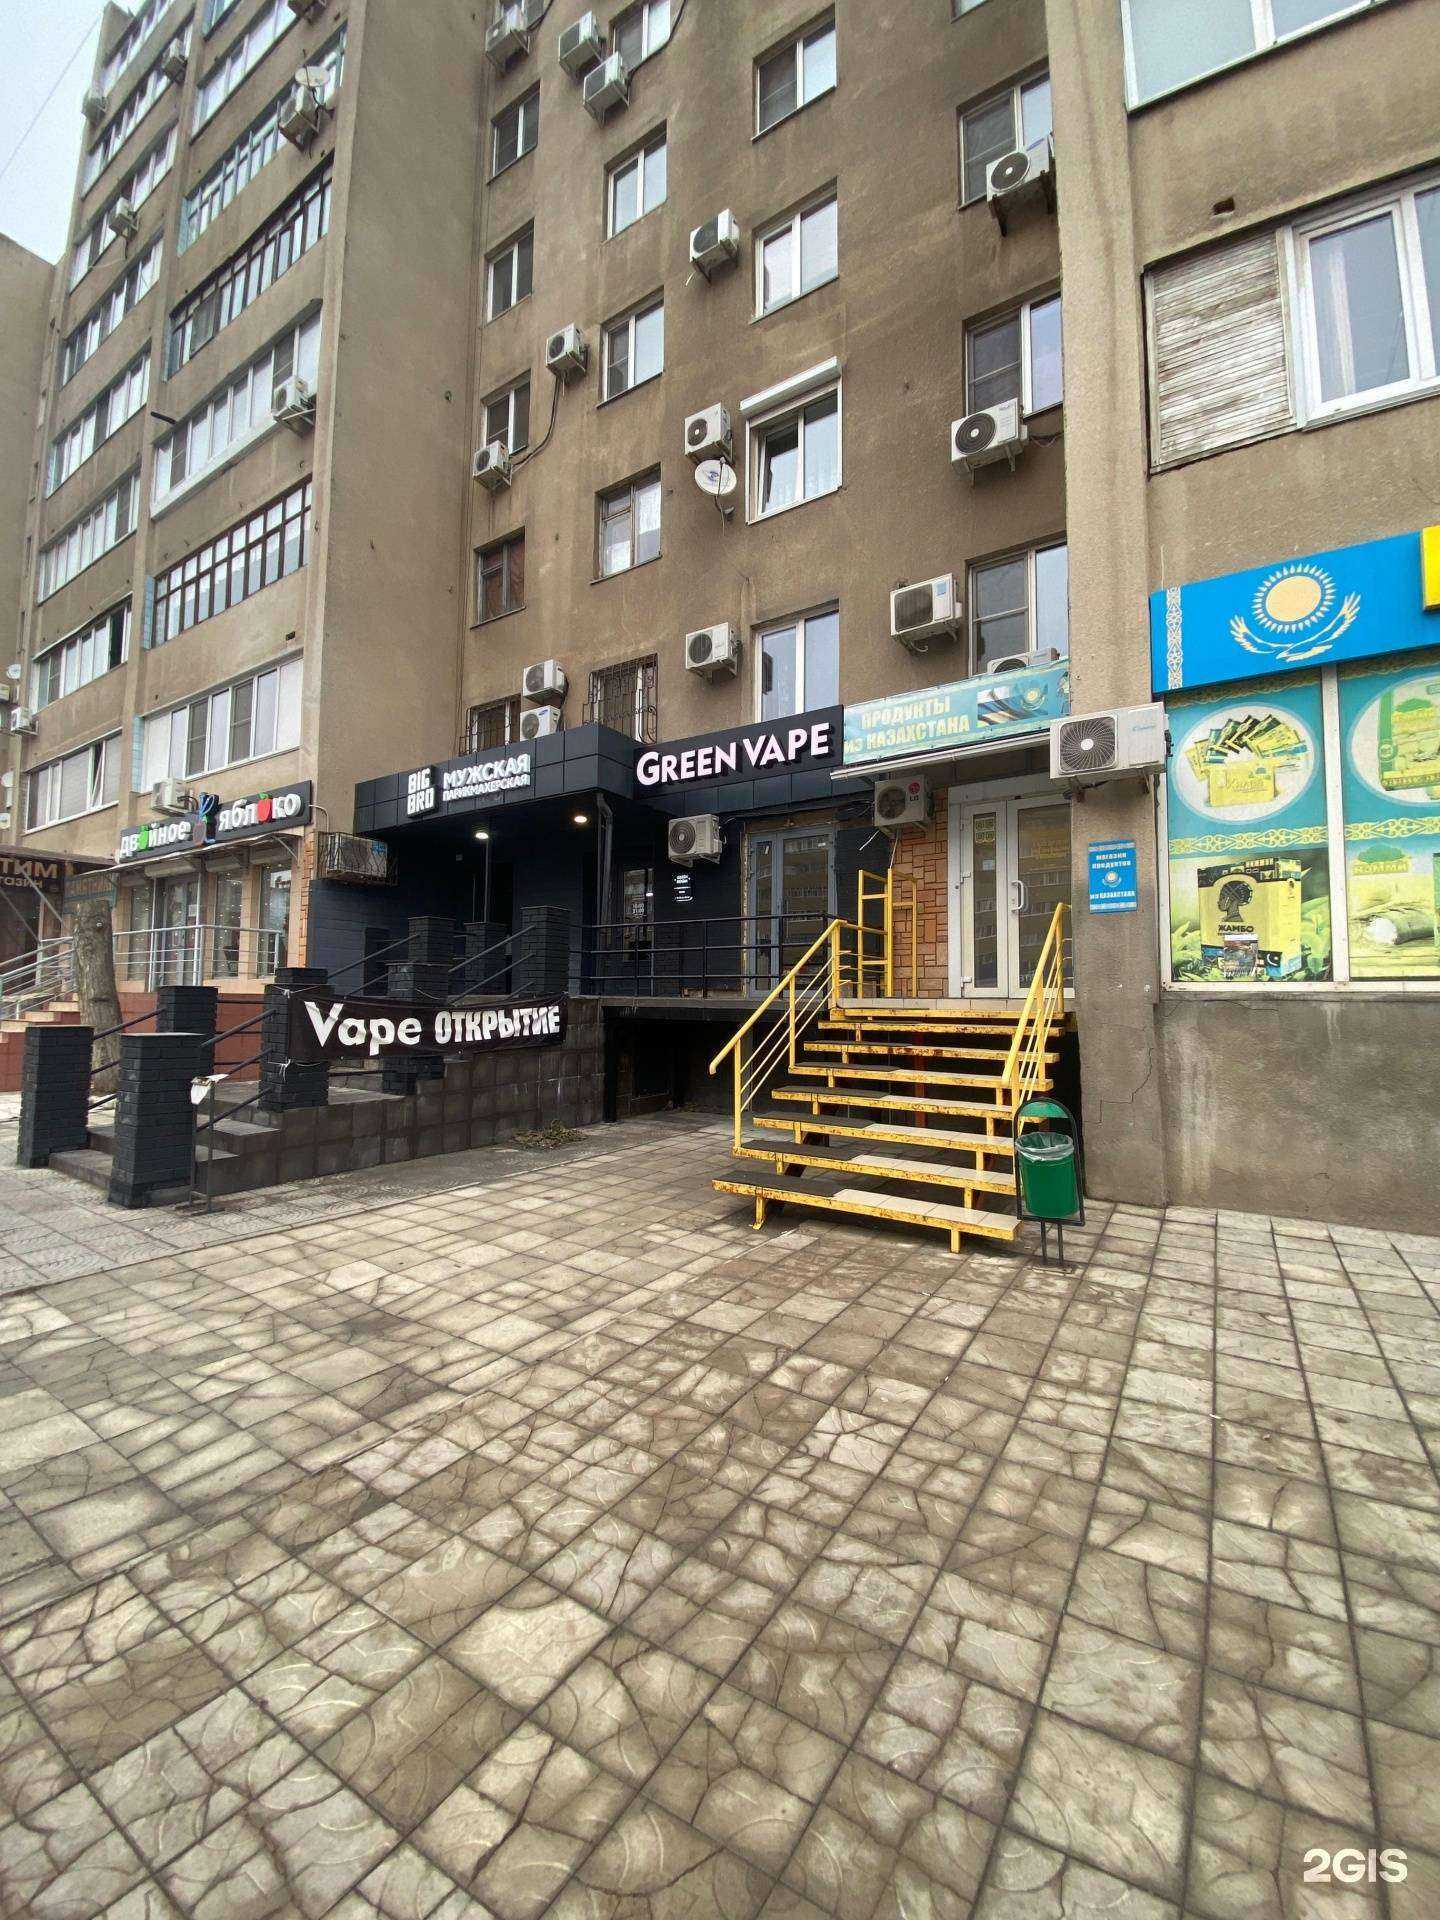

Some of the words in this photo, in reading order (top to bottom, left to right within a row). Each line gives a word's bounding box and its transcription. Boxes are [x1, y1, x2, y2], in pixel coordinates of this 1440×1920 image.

[861, 696, 951, 729] ПРОДУКТЫ
[866, 715, 970, 750] КАЗАХСТАНА
[443, 753, 531, 789] МУЖСКАЯ
[636, 742, 737, 786] GREEN
[742, 722, 830, 767] VAPE
[407, 788, 435, 815] BRO
[442, 774, 531, 802] ПАРИКМАХЕРСКАЯ
[1218, 925, 1254, 933] ЖАМБО
[304, 1001, 422, 1056] Vape
[434, 1005, 561, 1044] ОТКРЫТИЕ
